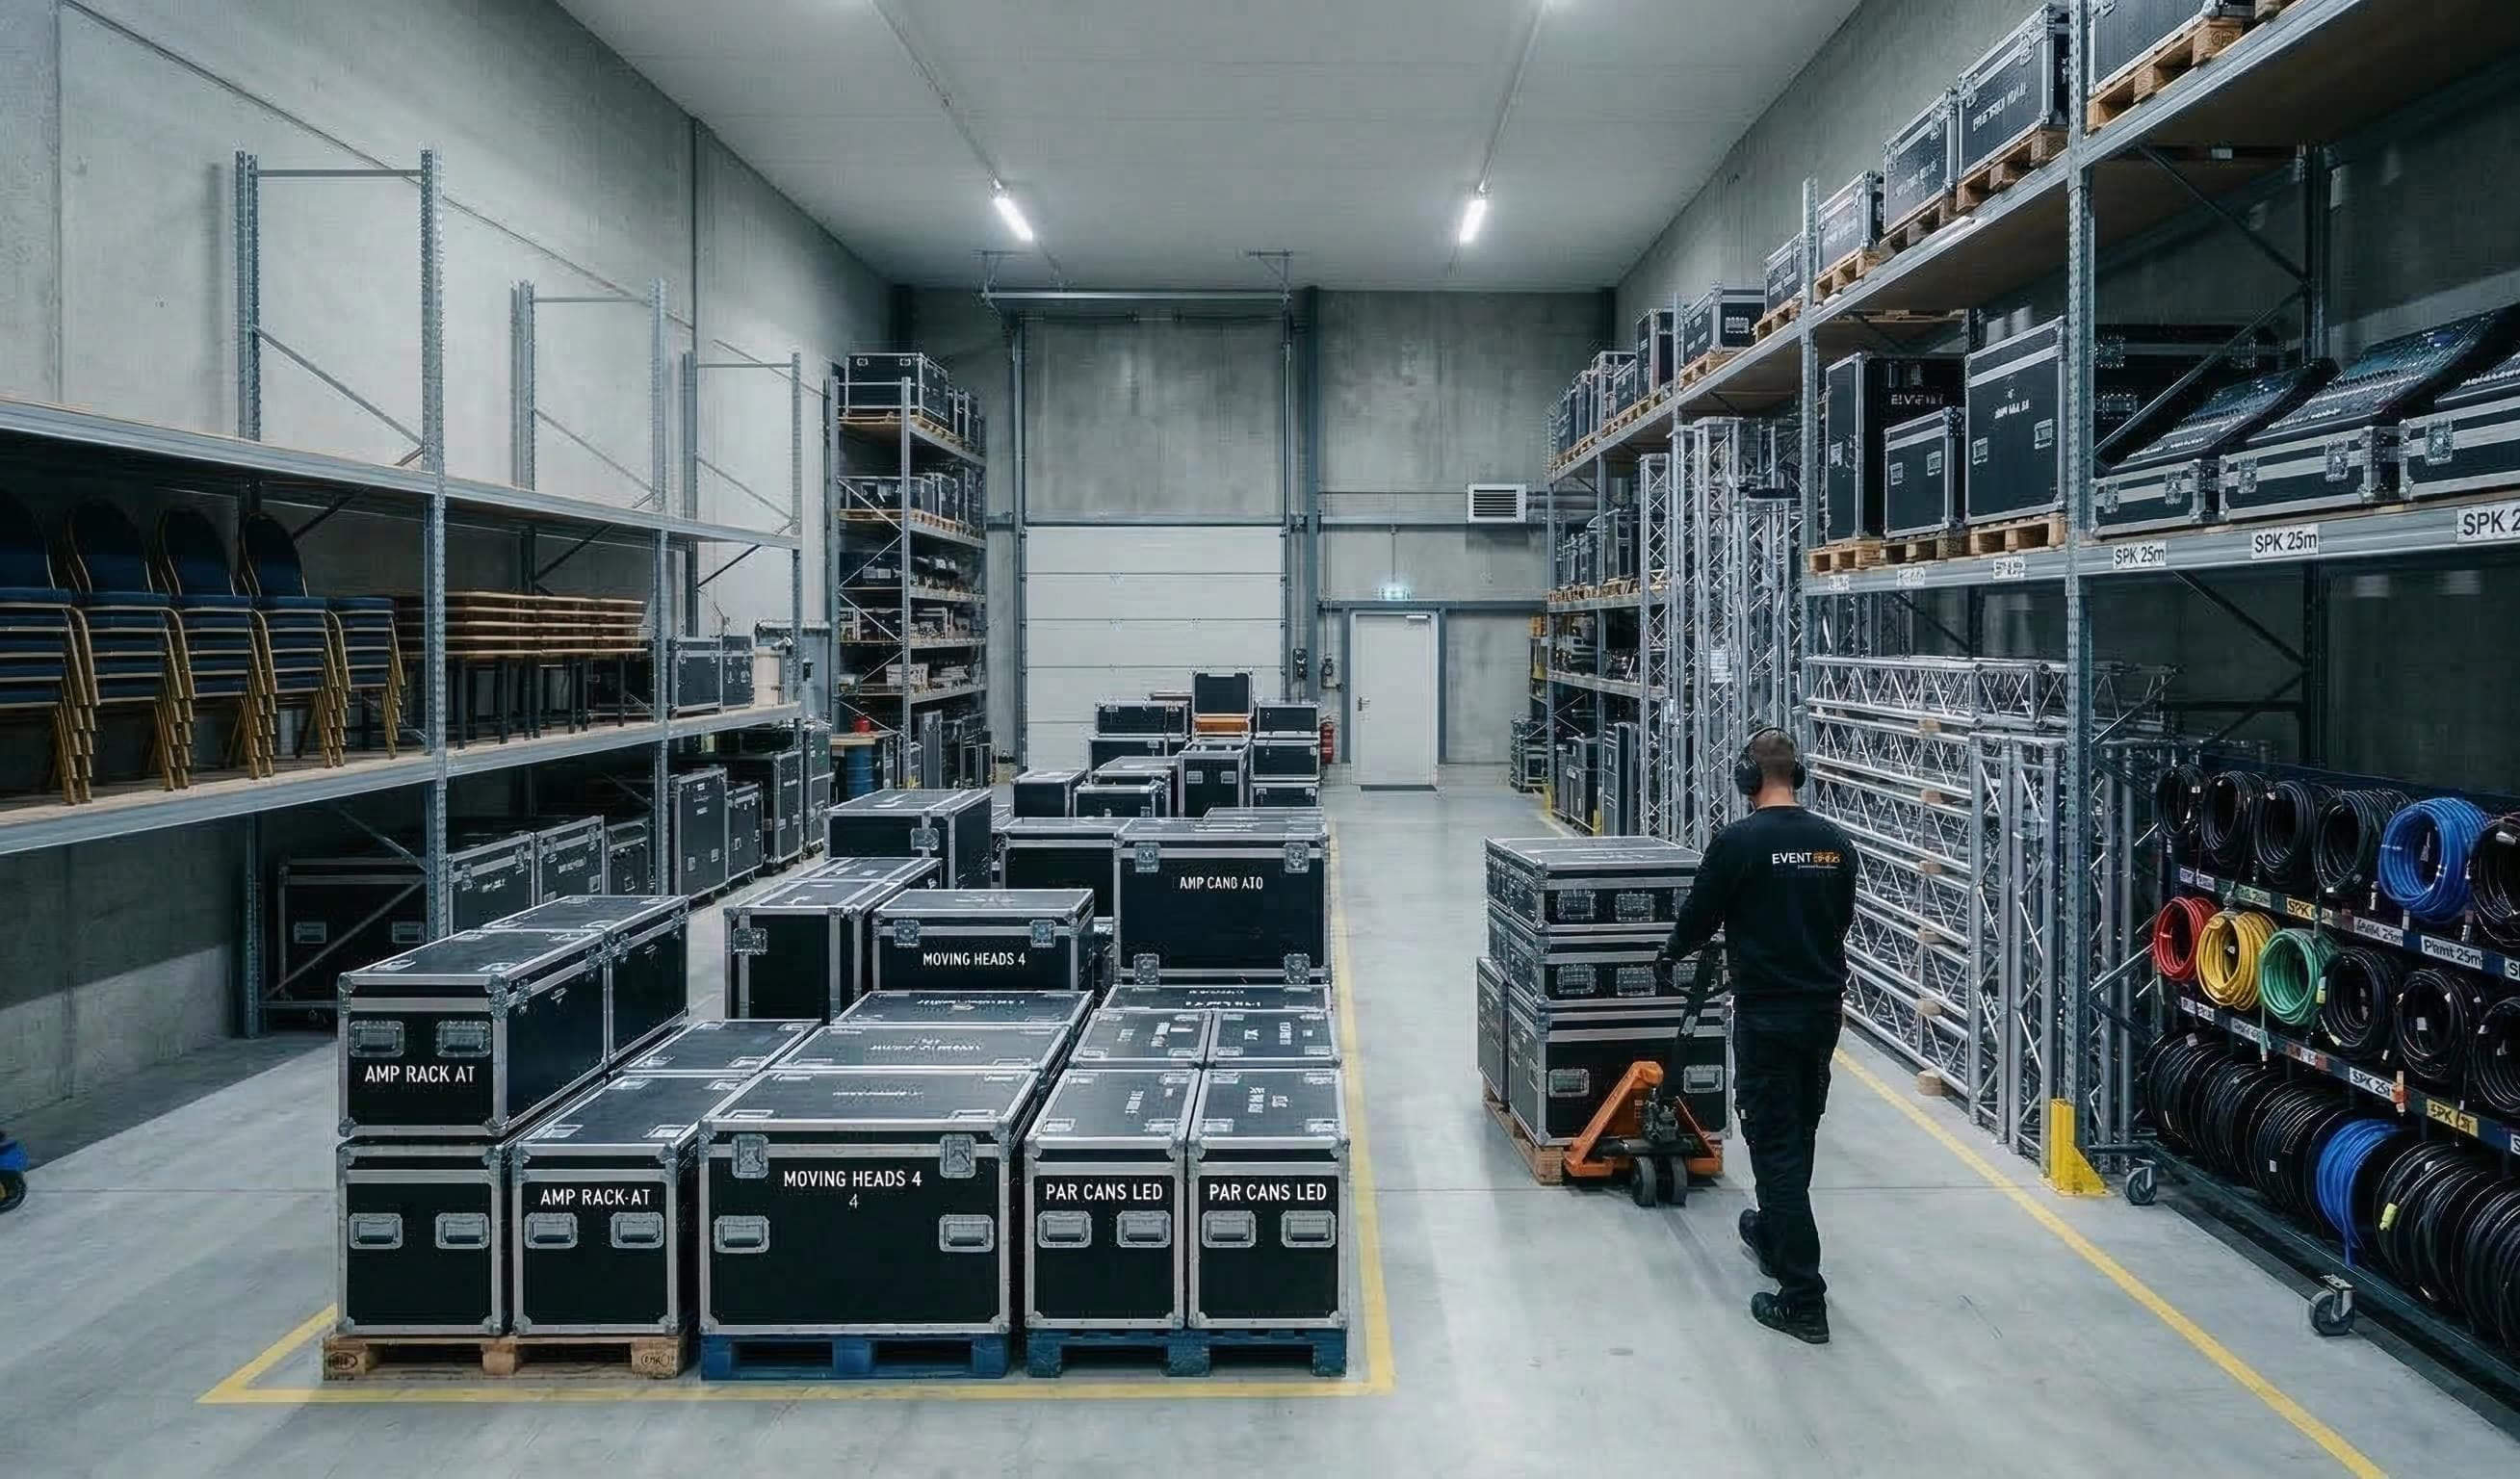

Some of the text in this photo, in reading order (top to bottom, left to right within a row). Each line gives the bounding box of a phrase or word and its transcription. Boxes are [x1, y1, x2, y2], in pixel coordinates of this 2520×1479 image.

[2462, 509, 2506, 536] SPK
[2254, 531, 2317, 554] SPK 25m
[2115, 545, 2165, 564] SPK 25m
[1772, 852, 1812, 865] EVENT
[1180, 876, 1205, 890] AMP
[922, 952, 1026, 966] MOVING HEADS 4
[2456, 948, 2481, 967] 25m
[2509, 962, 2520, 977] S
[364, 1065, 475, 1083] AMP RACK AT
[784, 1170, 922, 1187] MOVING HEADS 4
[540, 1188, 576, 1206] AMP
[848, 1194, 859, 1208] 4
[1046, 1183, 1163, 1201] PAR CANS LED
[1208, 1183, 1327, 1202] PAR CANS LED
